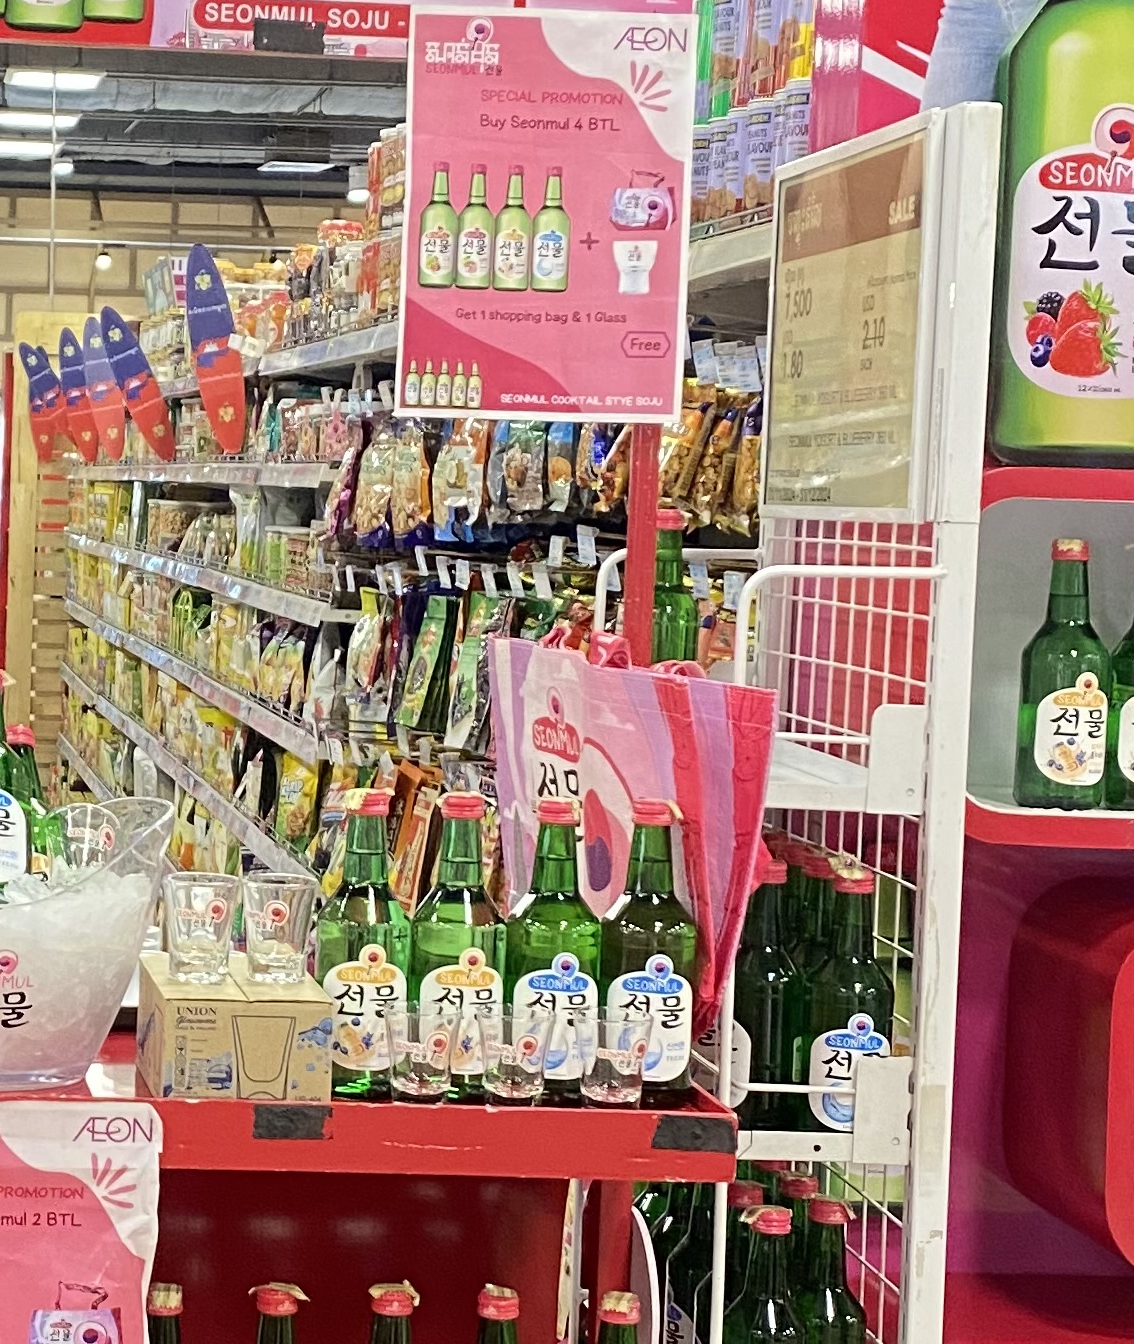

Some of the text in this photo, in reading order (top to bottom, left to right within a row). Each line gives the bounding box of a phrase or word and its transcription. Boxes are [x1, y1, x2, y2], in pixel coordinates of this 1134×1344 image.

[327, 7, 390, 29] SOJU
[480, 89, 624, 106] SPECIAL PROMOTION
[480, 113, 621, 132] Buy Seonmul 4 BTL
[1048, 159, 1134, 188] SEONM
[888, 194, 917, 226] SALE
[1031, 195, 1134, 277] 선
[455, 308, 477, 321] Get
[489, 310, 542, 324] shopping
[545, 311, 569, 325] bag
[572, 311, 582, 323] &
[594, 312, 627, 323] Glass
[630, 337, 662, 352] Free
[532, 976, 586, 991] SEONMUL
[626, 978, 681, 993] SEONMUL
[176, 1006, 218, 1017] UNION
[828, 1036, 883, 1050] SEONMUL
[32, 1212, 41, 1226] 2
[46, 1212, 82, 1227] BTL
